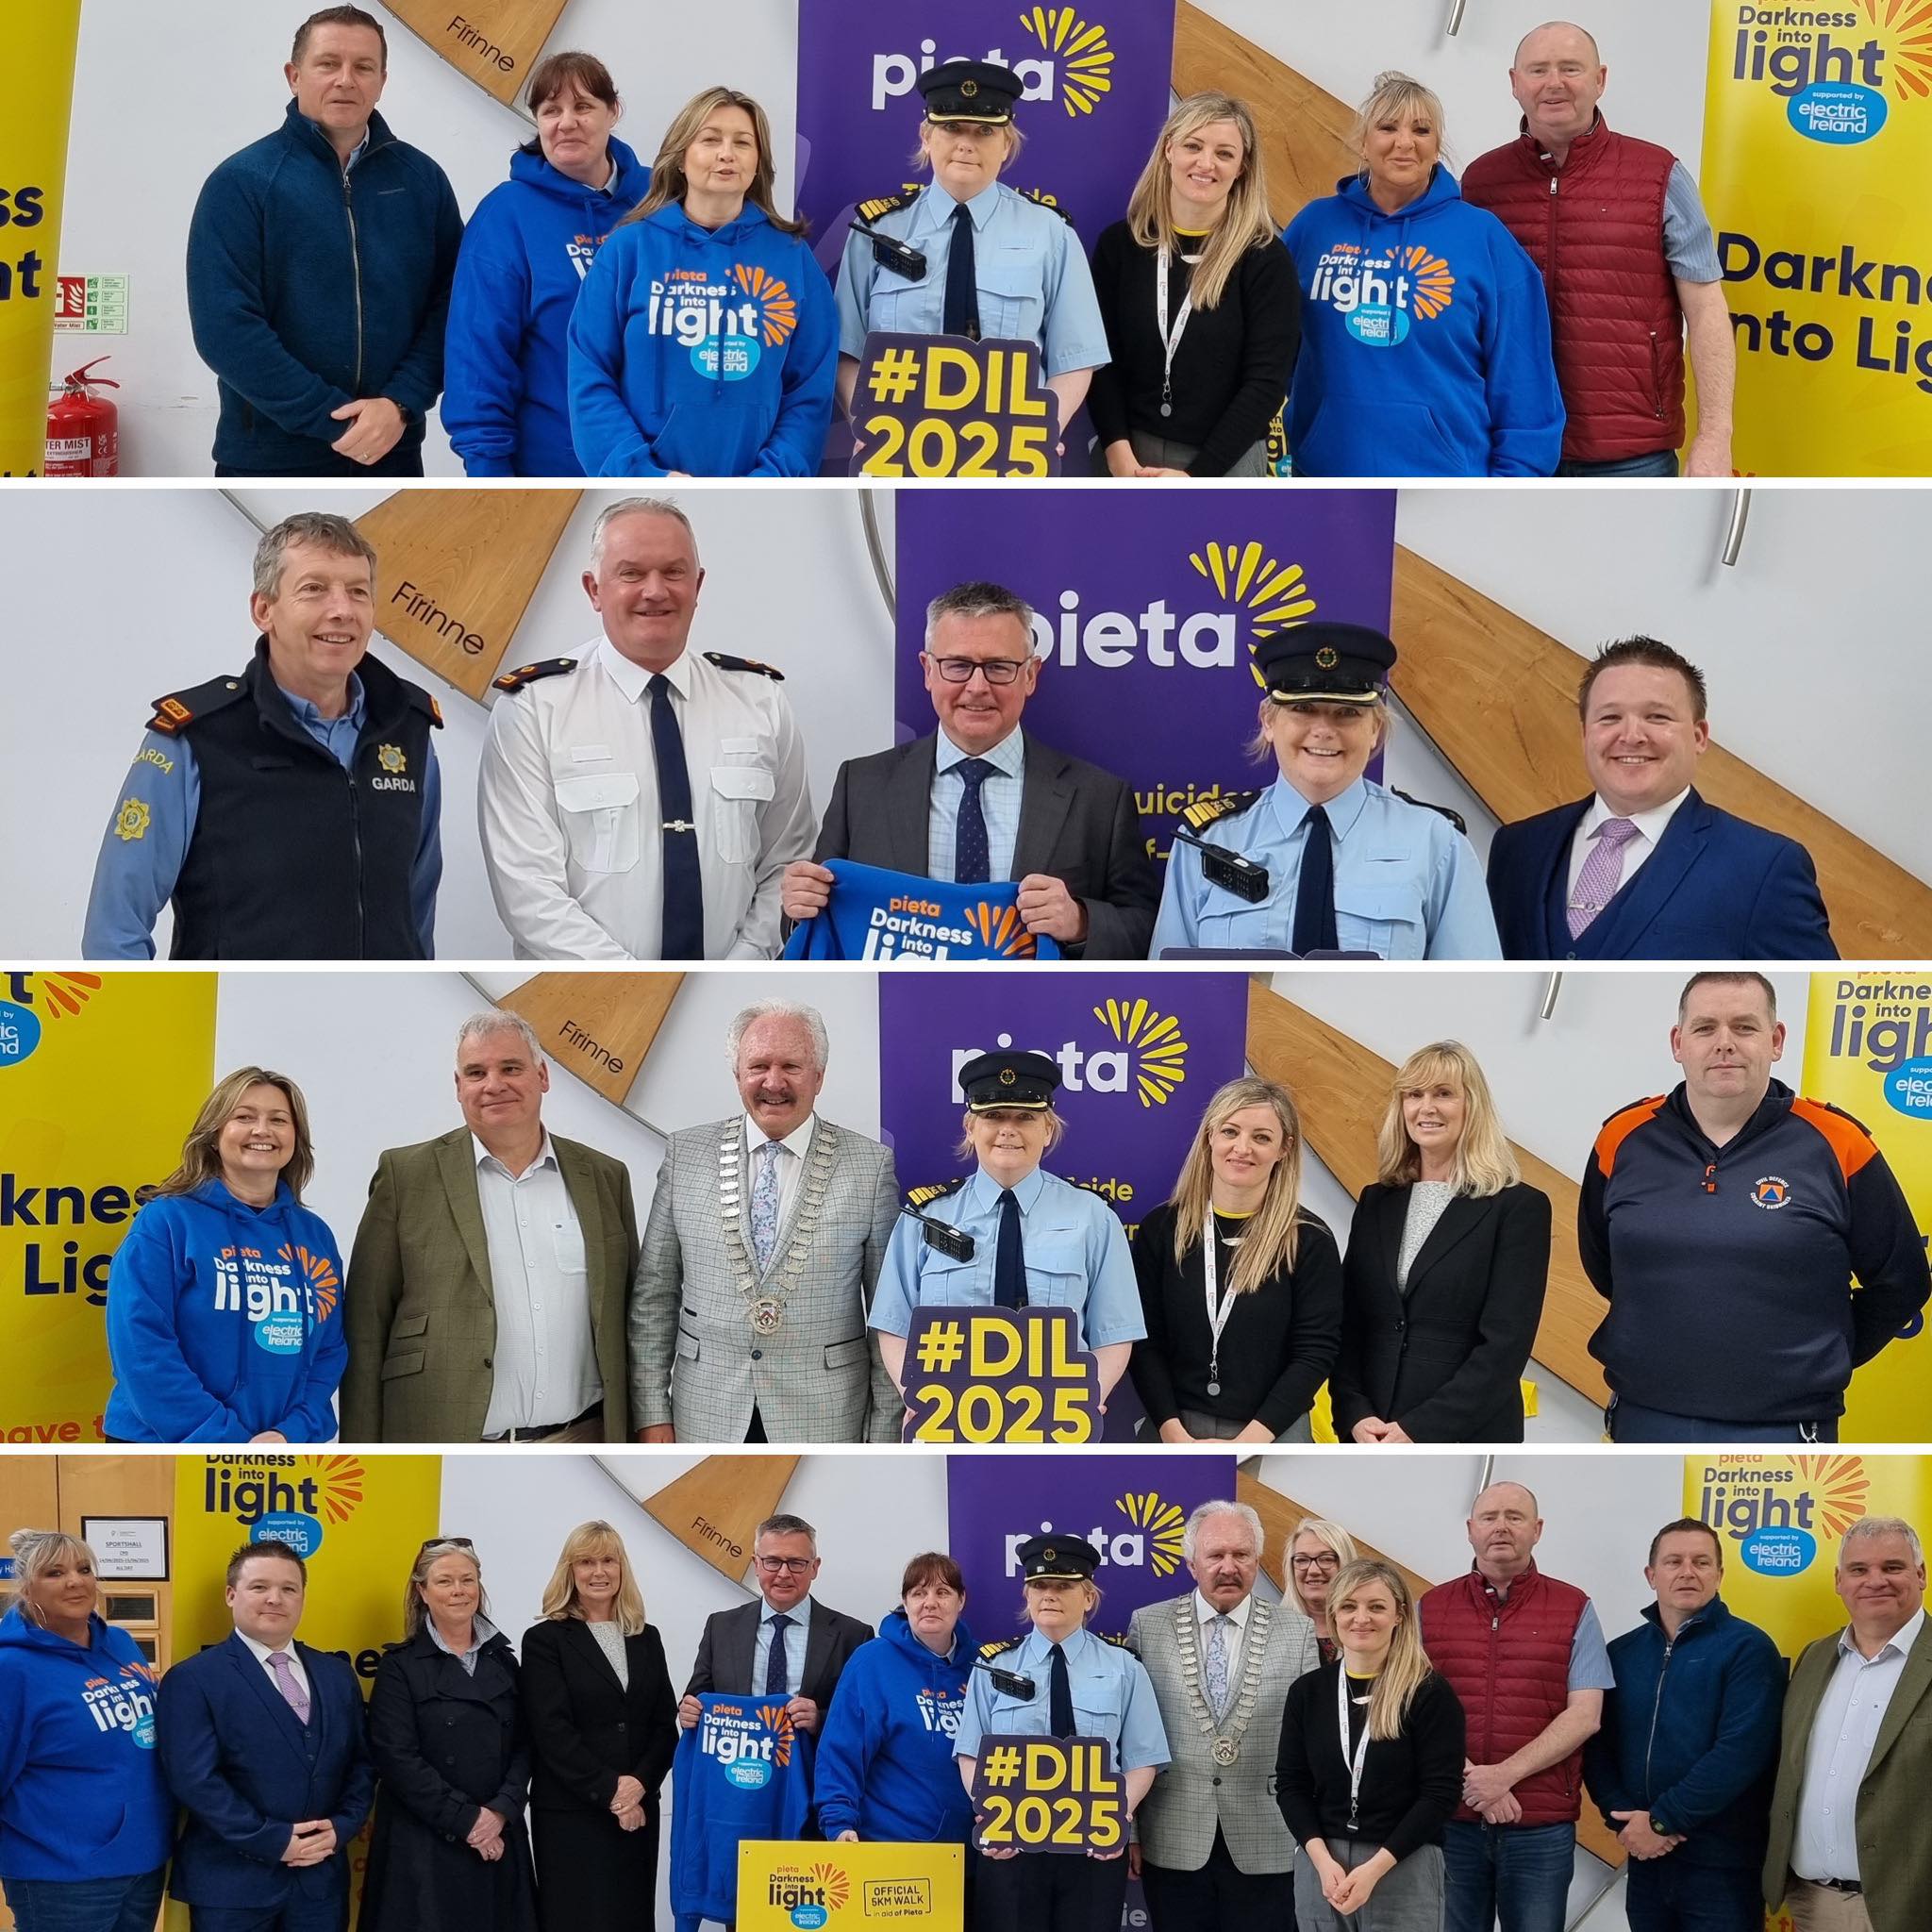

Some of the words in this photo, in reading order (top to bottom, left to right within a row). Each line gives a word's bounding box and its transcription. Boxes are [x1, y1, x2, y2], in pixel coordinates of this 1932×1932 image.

[1738, 6, 1857, 27] Darkness
[446, 15, 514, 72] Fírinne
[1777, 28, 1812, 43] into
[1733, 29, 1885, 97] light
[872, 39, 1055, 110] pia
[1812, 92, 1853, 100] supported
[1855, 92, 1864, 101] by
[1799, 102, 1866, 119] electric
[1809, 116, 1867, 134] Ireland
[1718, 232, 1932, 305] Darkn
[1309, 267, 1409, 312] light
[680, 296, 707, 307] into
[648, 295, 758, 346] light
[1729, 310, 1834, 361] nto
[707, 359, 747, 372] Ireand
[868, 346, 1046, 416] #DIL
[45, 439, 60, 450] TER
[64, 438, 90, 449] MIST
[862, 415, 1048, 477] 2025
[391, 581, 484, 655] Fírinne
[372, 777, 415, 793] GARDA
[1134, 783, 1237, 814] uicid
[890, 895, 941, 918] pieta
[871, 908, 973, 945] Darkness
[902, 936, 932, 954] into
[1875, 1003, 1912, 1017] into
[558, 1020, 623, 1074] Fírinne
[951, 1033, 1128, 1104] pta
[1907, 1091, 1932, 1107] Irel
[213, 1257, 291, 1275] Dakness
[214, 1272, 313, 1321] light
[917, 1318, 1086, 1377] #DIL
[915, 1384, 1091, 1443] 2025
[0, 1422, 80, 1443] ave
[207, 1455, 295, 1467] Darkness
[239, 1468, 265, 1479] into
[1704, 1467, 1793, 1483] Darkness
[205, 1468, 318, 1525] light
[1733, 1485, 1759, 1496] into
[1701, 1487, 1814, 1540] light
[258, 1528, 308, 1541] electric
[1006, 1522, 1143, 1577] pta
[1750, 1543, 1801, 1556] electric
[1757, 1555, 1801, 1567] Ireland
[109, 1693, 125, 1703] int
[89, 1689, 156, 1732] ligh
[712, 1704, 742, 1716] pieta
[704, 1713, 761, 1730] Darkness
[721, 1727, 740, 1737] into
[702, 1725, 774, 1764] light
[984, 1743, 1117, 1792] #DIL
[982, 1795, 1121, 1847] 2025
[770, 1874, 814, 1883] Darkness
[777, 1865, 799, 1874] pieta
[769, 1884, 824, 1911] light
[874, 1885, 920, 1895] OFFICIAL
[872, 1897, 891, 1907] 5KM
[893, 1895, 924, 1905] WALK
